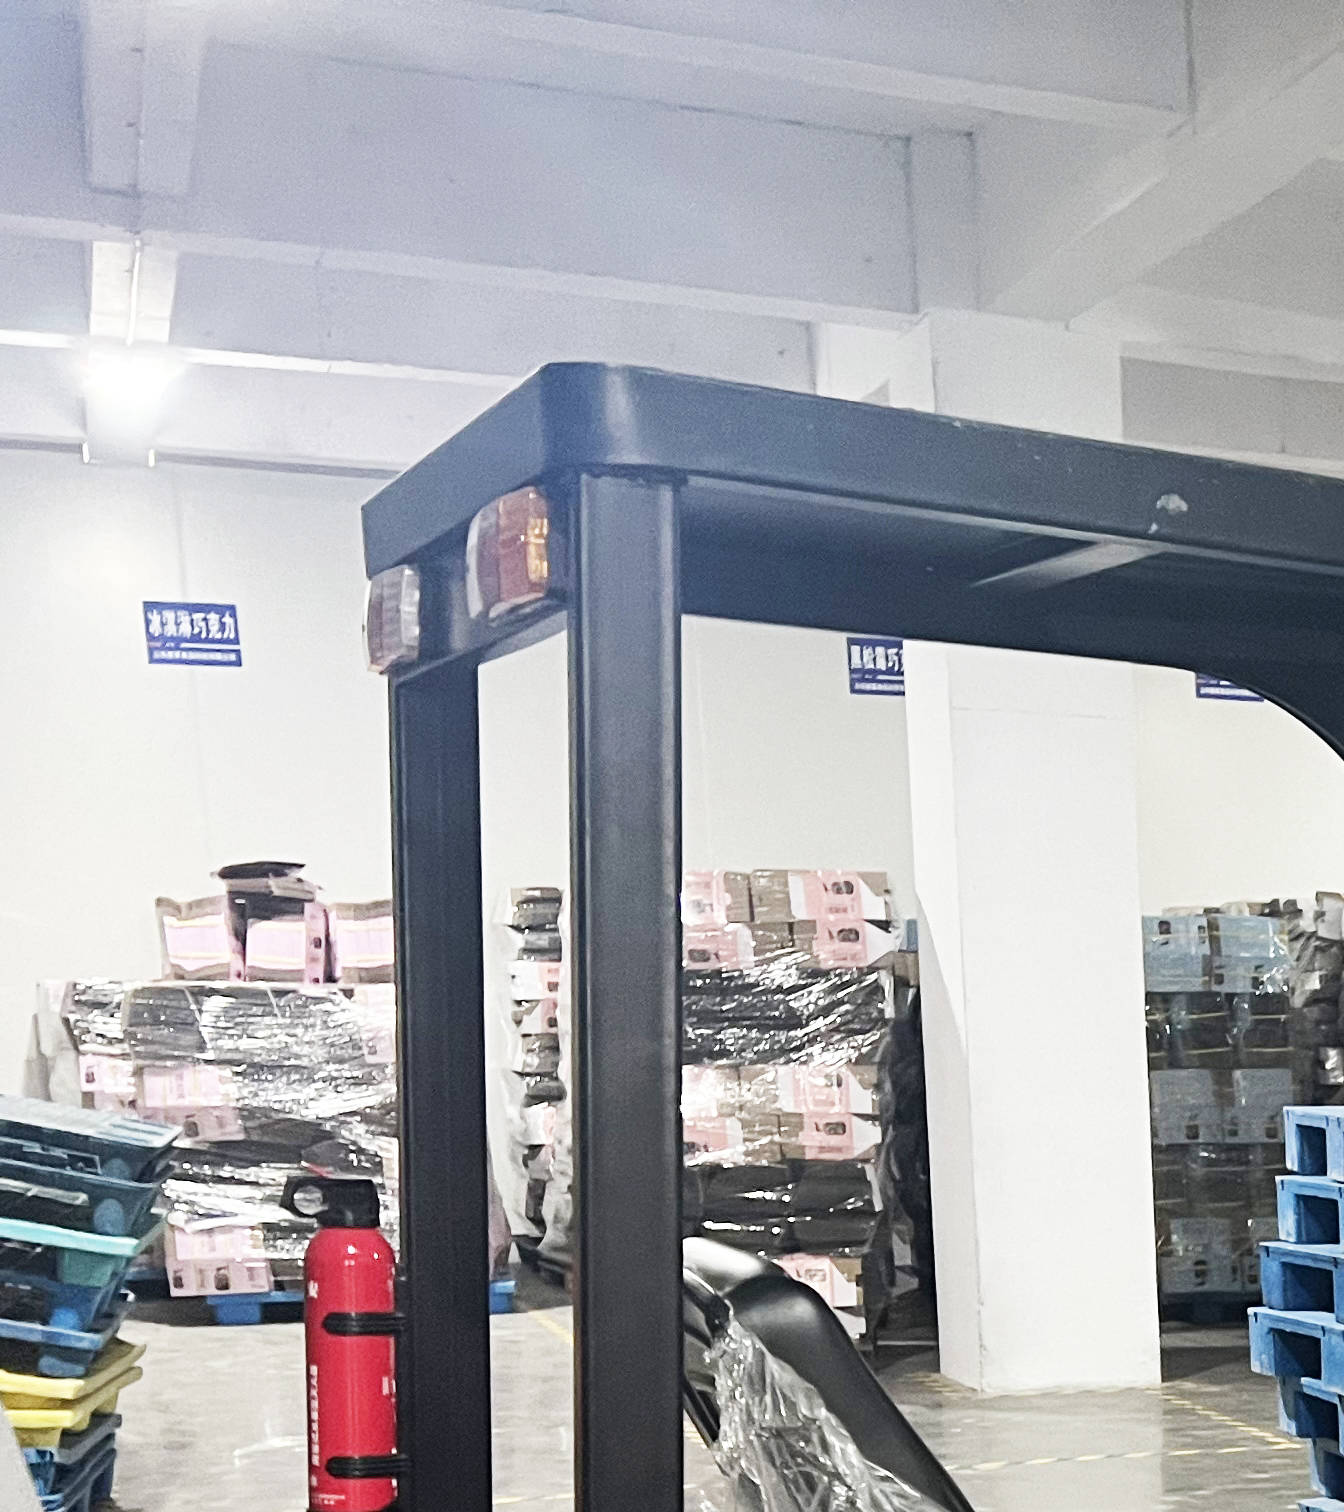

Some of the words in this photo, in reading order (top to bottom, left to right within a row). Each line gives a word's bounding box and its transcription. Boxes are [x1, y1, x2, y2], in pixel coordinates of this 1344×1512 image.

[147, 608, 236, 640] 冰淇淋巧克力
